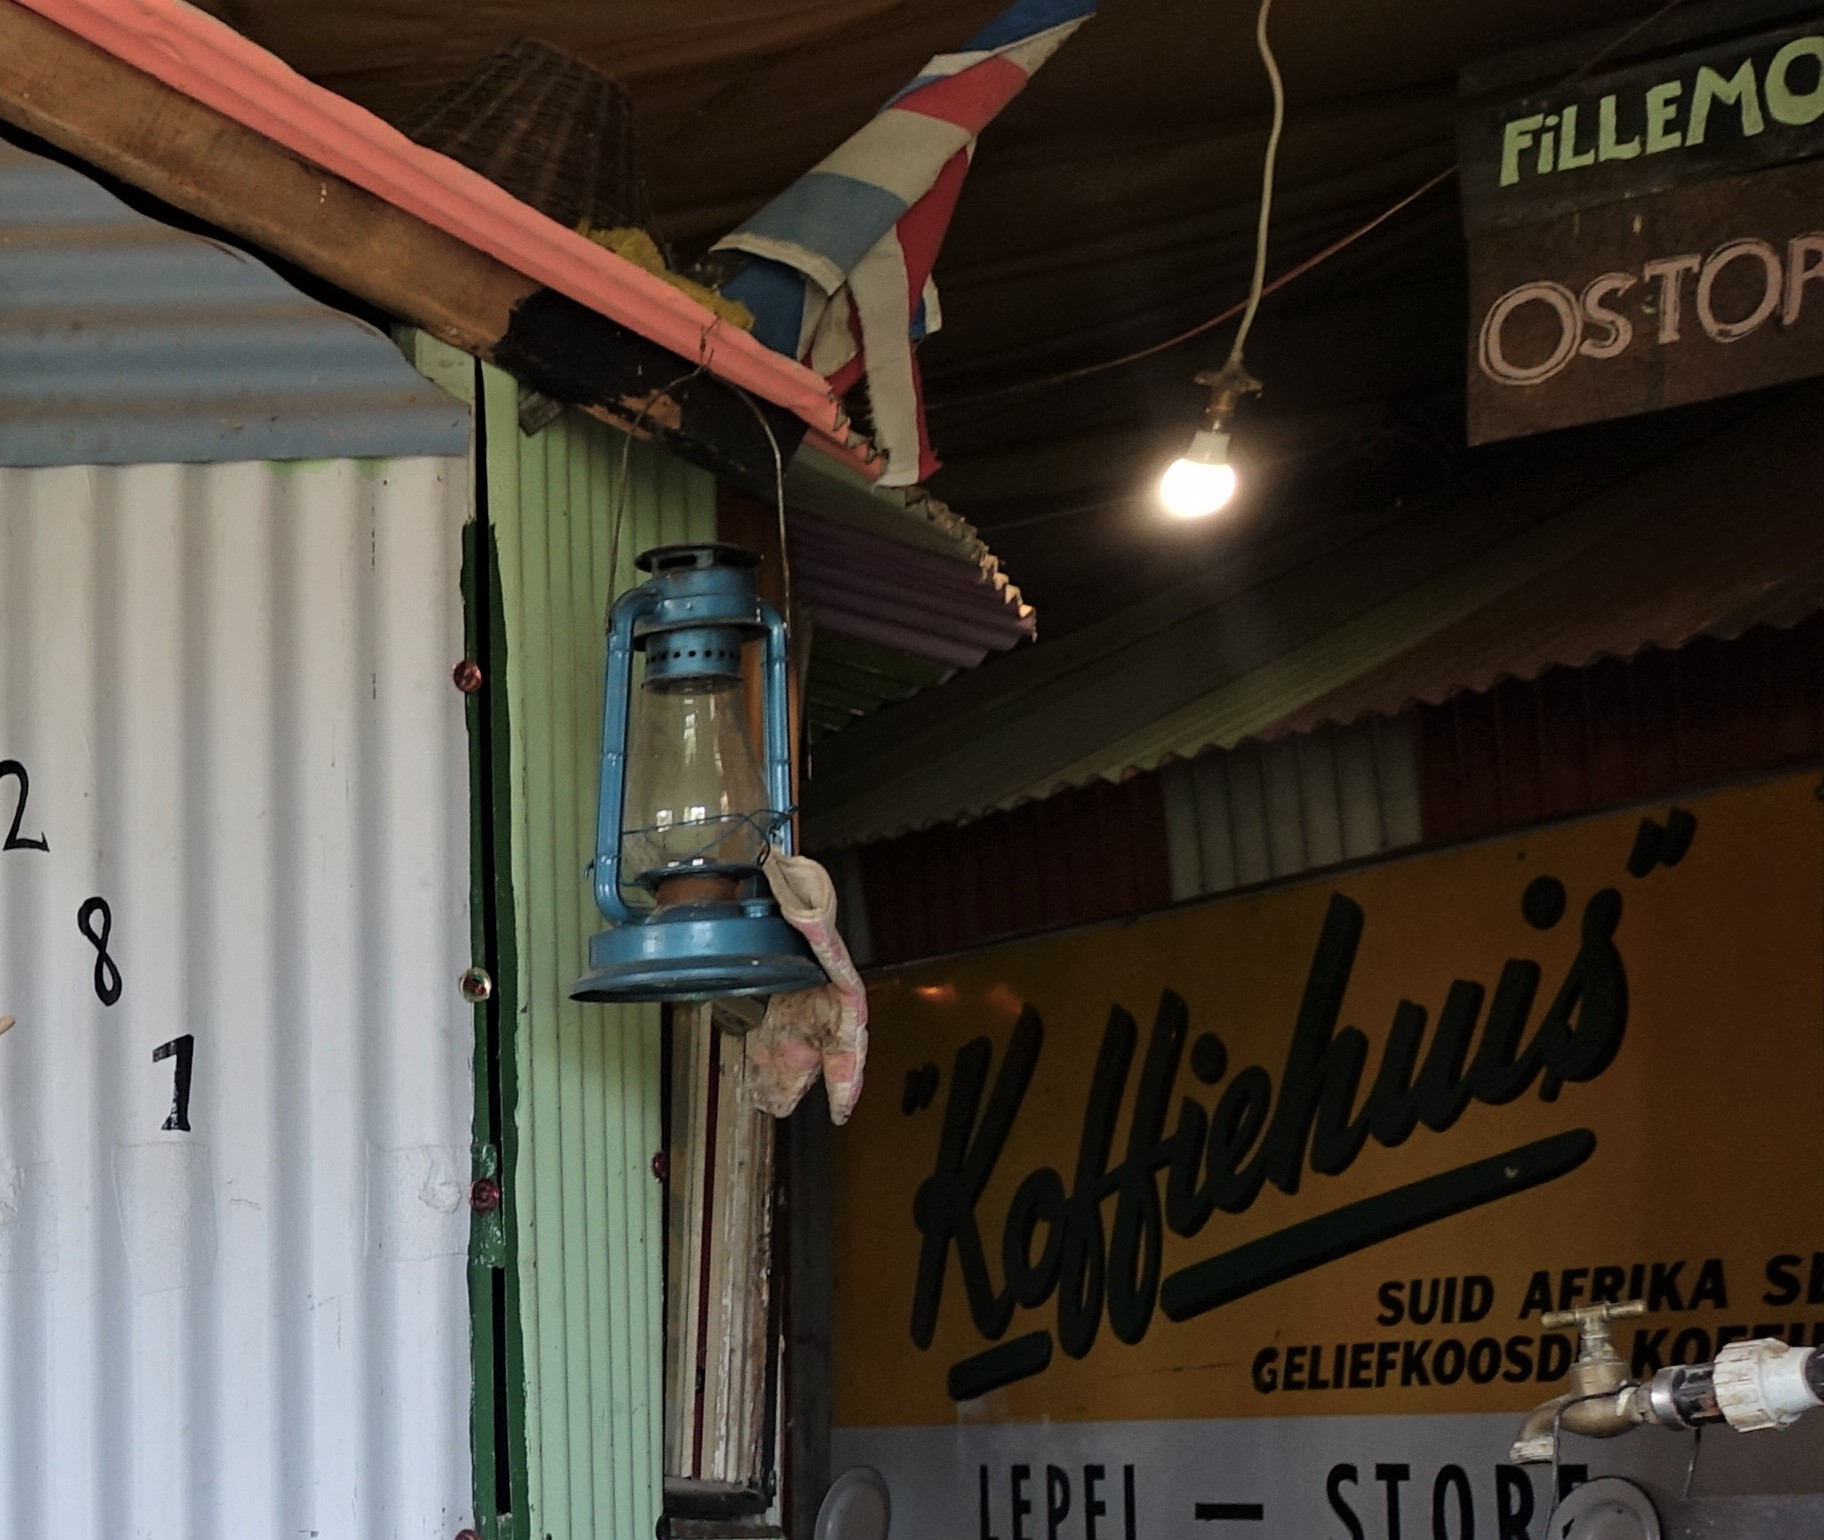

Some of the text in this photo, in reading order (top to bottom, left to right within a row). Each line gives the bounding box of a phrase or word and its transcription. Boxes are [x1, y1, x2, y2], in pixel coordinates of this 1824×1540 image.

[1377, 1275, 1494, 1327] SUID
[1518, 1259, 1729, 1320] AFRIKA
[1252, 1333, 1583, 1393] GELIEFKOOSD
